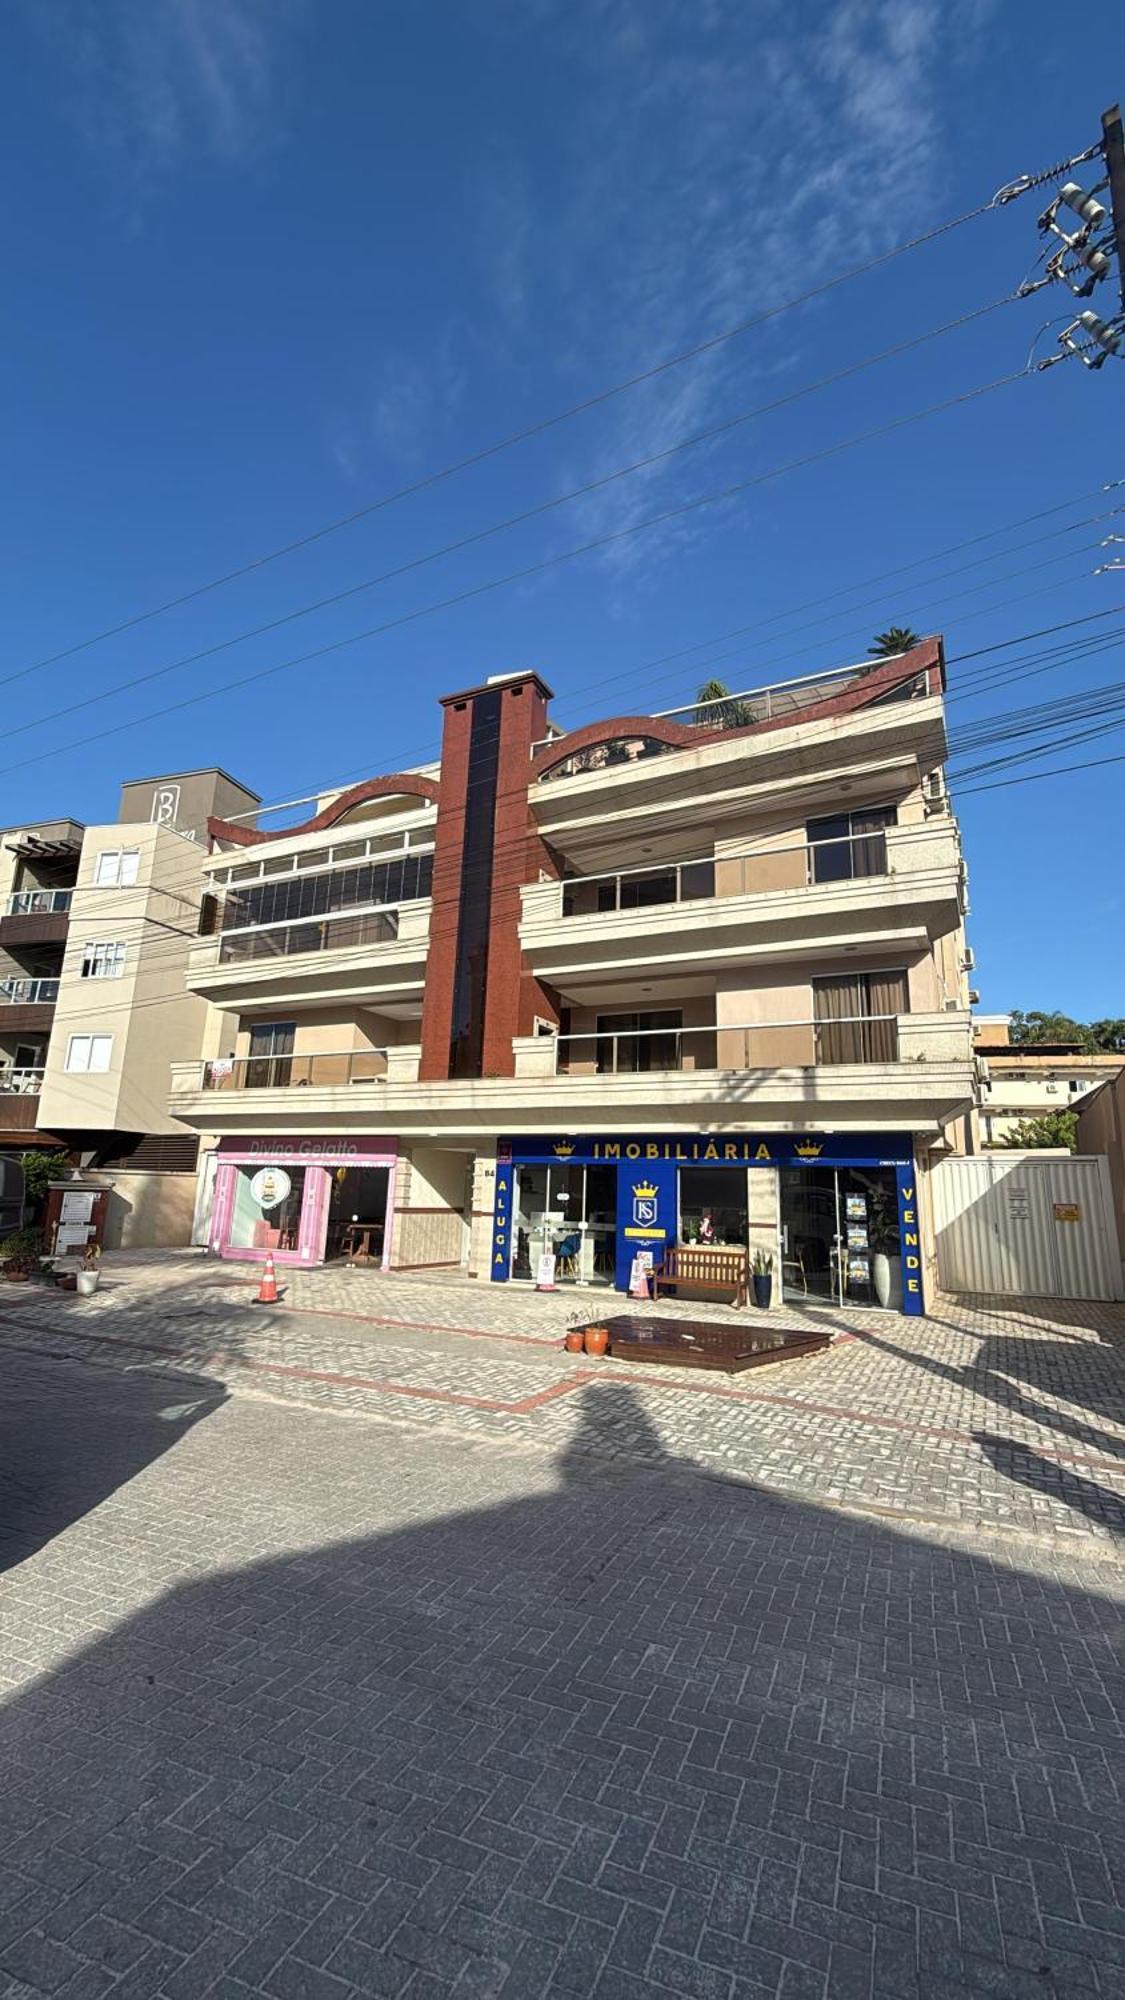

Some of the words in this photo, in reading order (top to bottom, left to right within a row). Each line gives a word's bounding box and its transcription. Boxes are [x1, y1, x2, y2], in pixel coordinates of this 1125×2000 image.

[250, 1141, 294, 1157] Divino
[299, 1140, 358, 1158] Gelatto
[594, 1138, 772, 1160] IMOBILIÁRIA
[495, 1180, 507, 1264] ALUGA
[902, 1188, 919, 1292] VENDE
